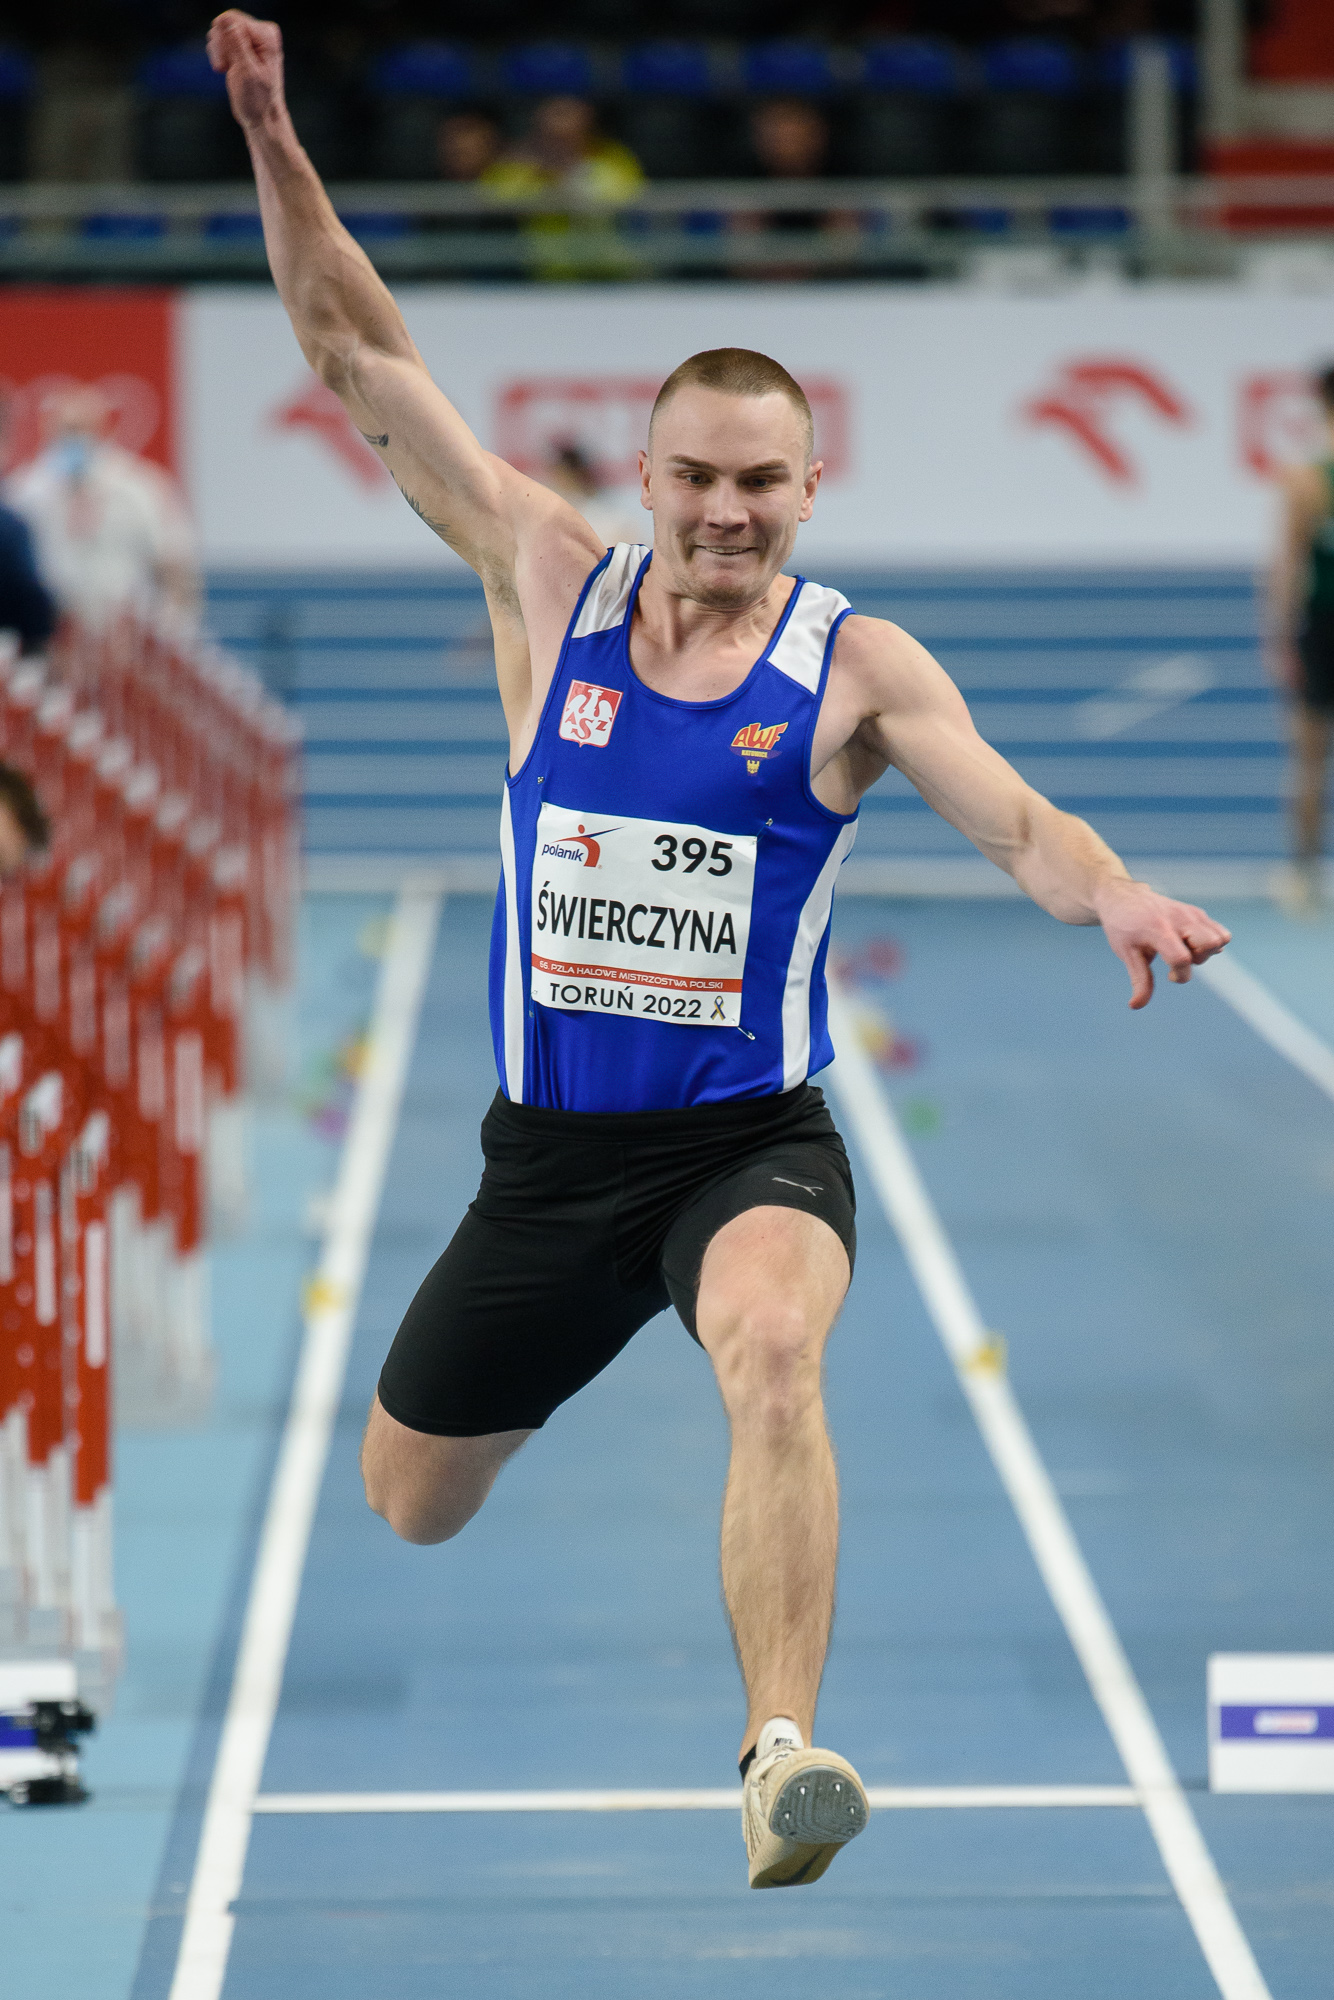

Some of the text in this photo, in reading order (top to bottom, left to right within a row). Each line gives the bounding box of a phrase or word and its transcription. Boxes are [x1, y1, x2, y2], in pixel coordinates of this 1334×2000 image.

[731, 722, 789, 750] AWF
[541, 843, 585, 862] polanik
[651, 834, 734, 877] 395
[536, 880, 738, 955] ŚWIERCZYNA
[550, 963, 576, 974] PZLA
[576, 966, 618, 979] HALOWE
[618, 972, 688, 988] MISTRZOSTWA
[689, 980, 724, 989] POLSKI
[549, 982, 702, 1018] TORUŃ 2022
